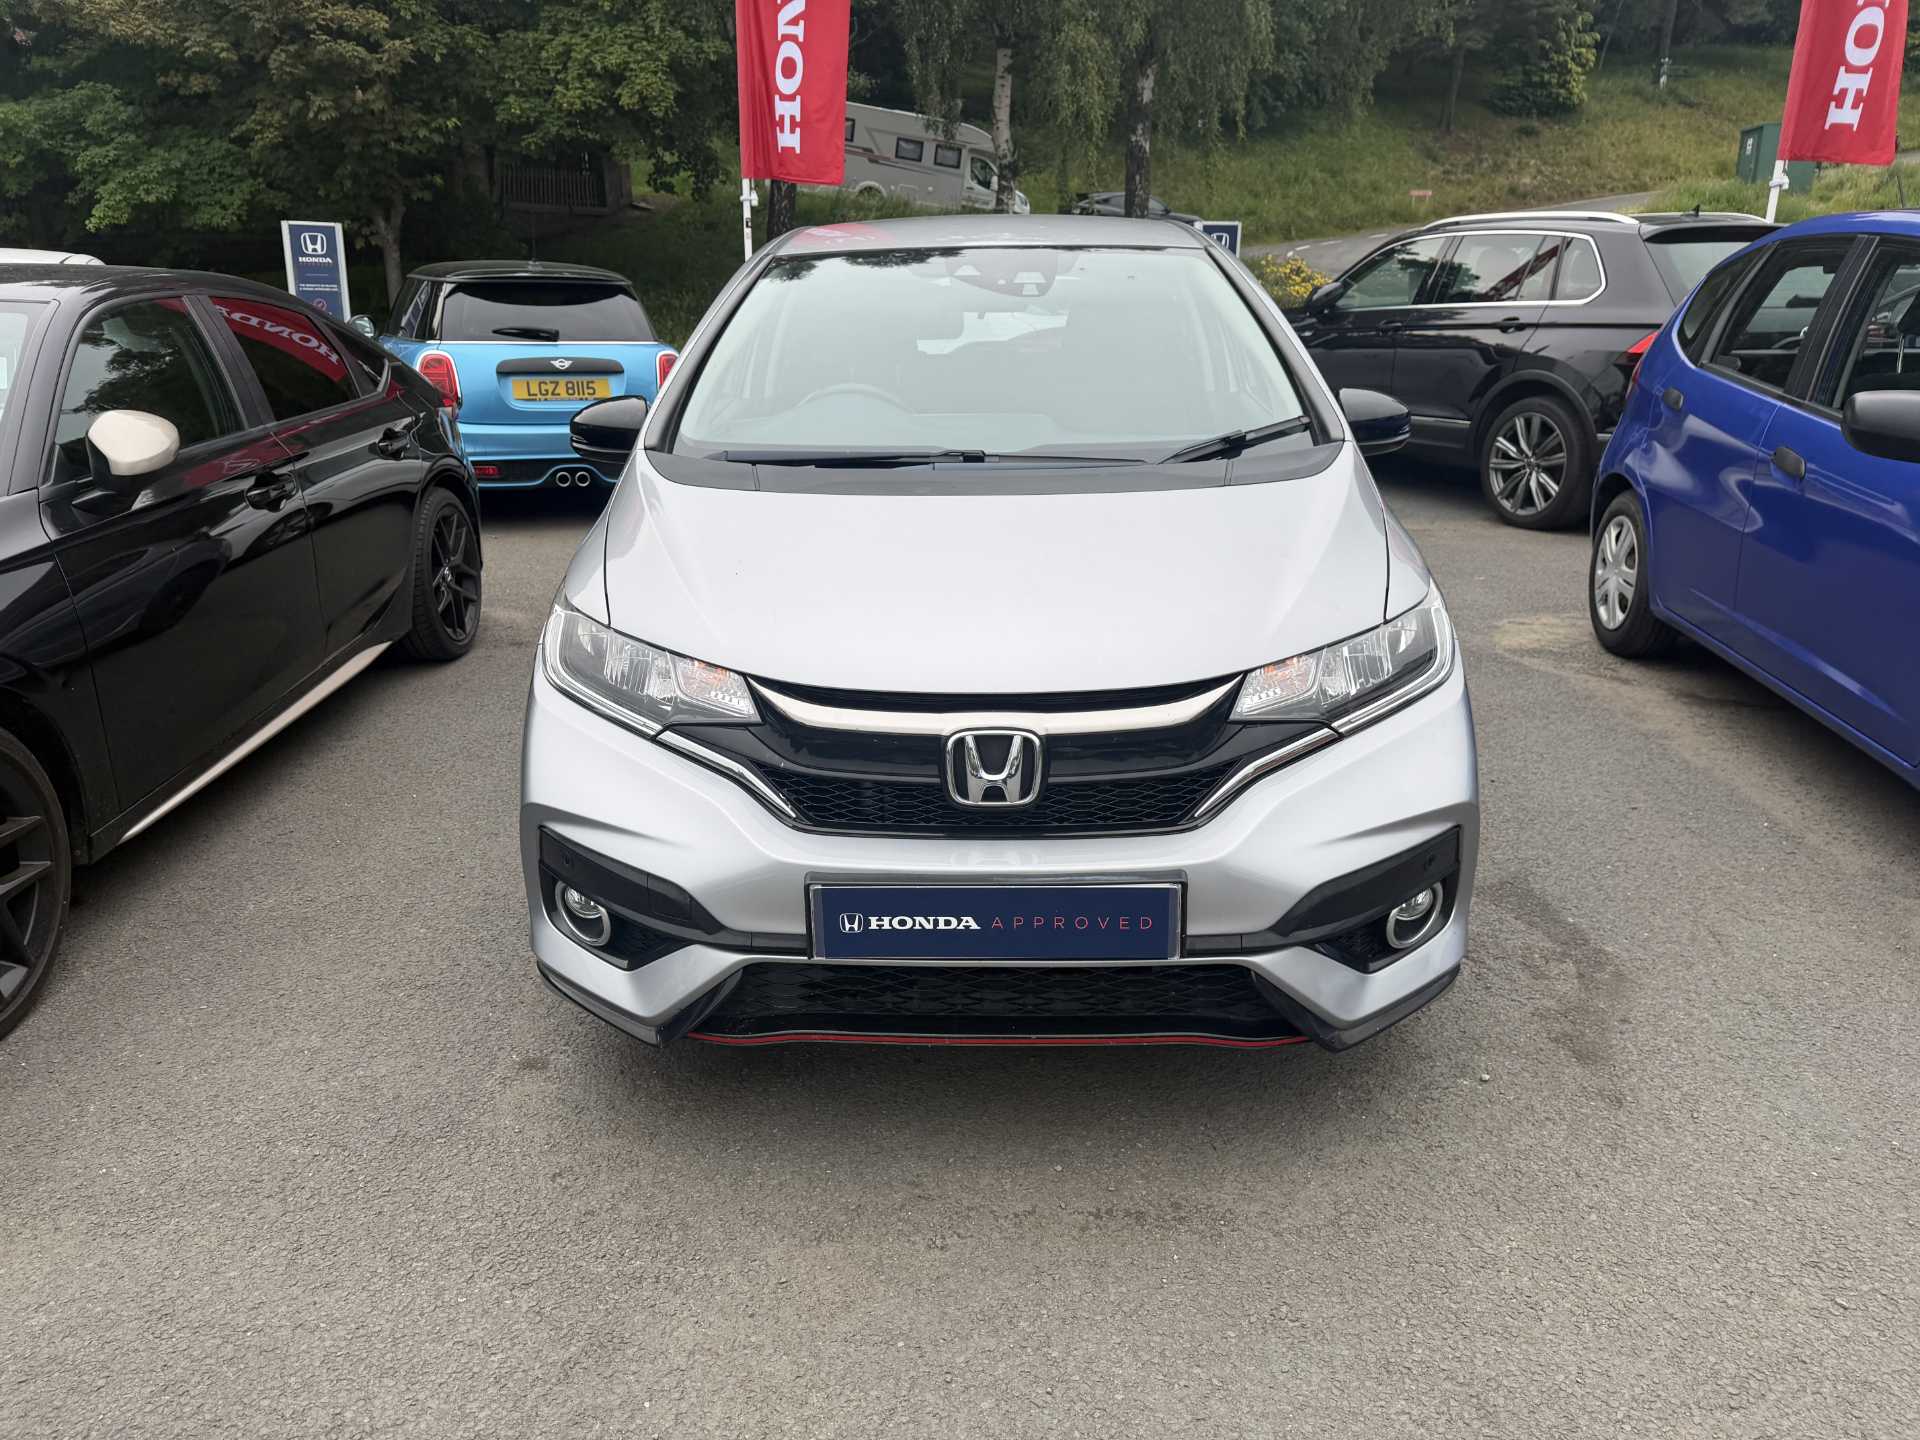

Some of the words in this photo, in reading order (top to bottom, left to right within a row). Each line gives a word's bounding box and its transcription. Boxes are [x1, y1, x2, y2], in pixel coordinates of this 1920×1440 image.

[1824, 0, 1890, 131] HO
[526, 381, 560, 396] LGZ
[565, 381, 596, 396] 8115
[868, 916, 981, 930] HONDA
[991, 916, 1153, 930] APPROVED
